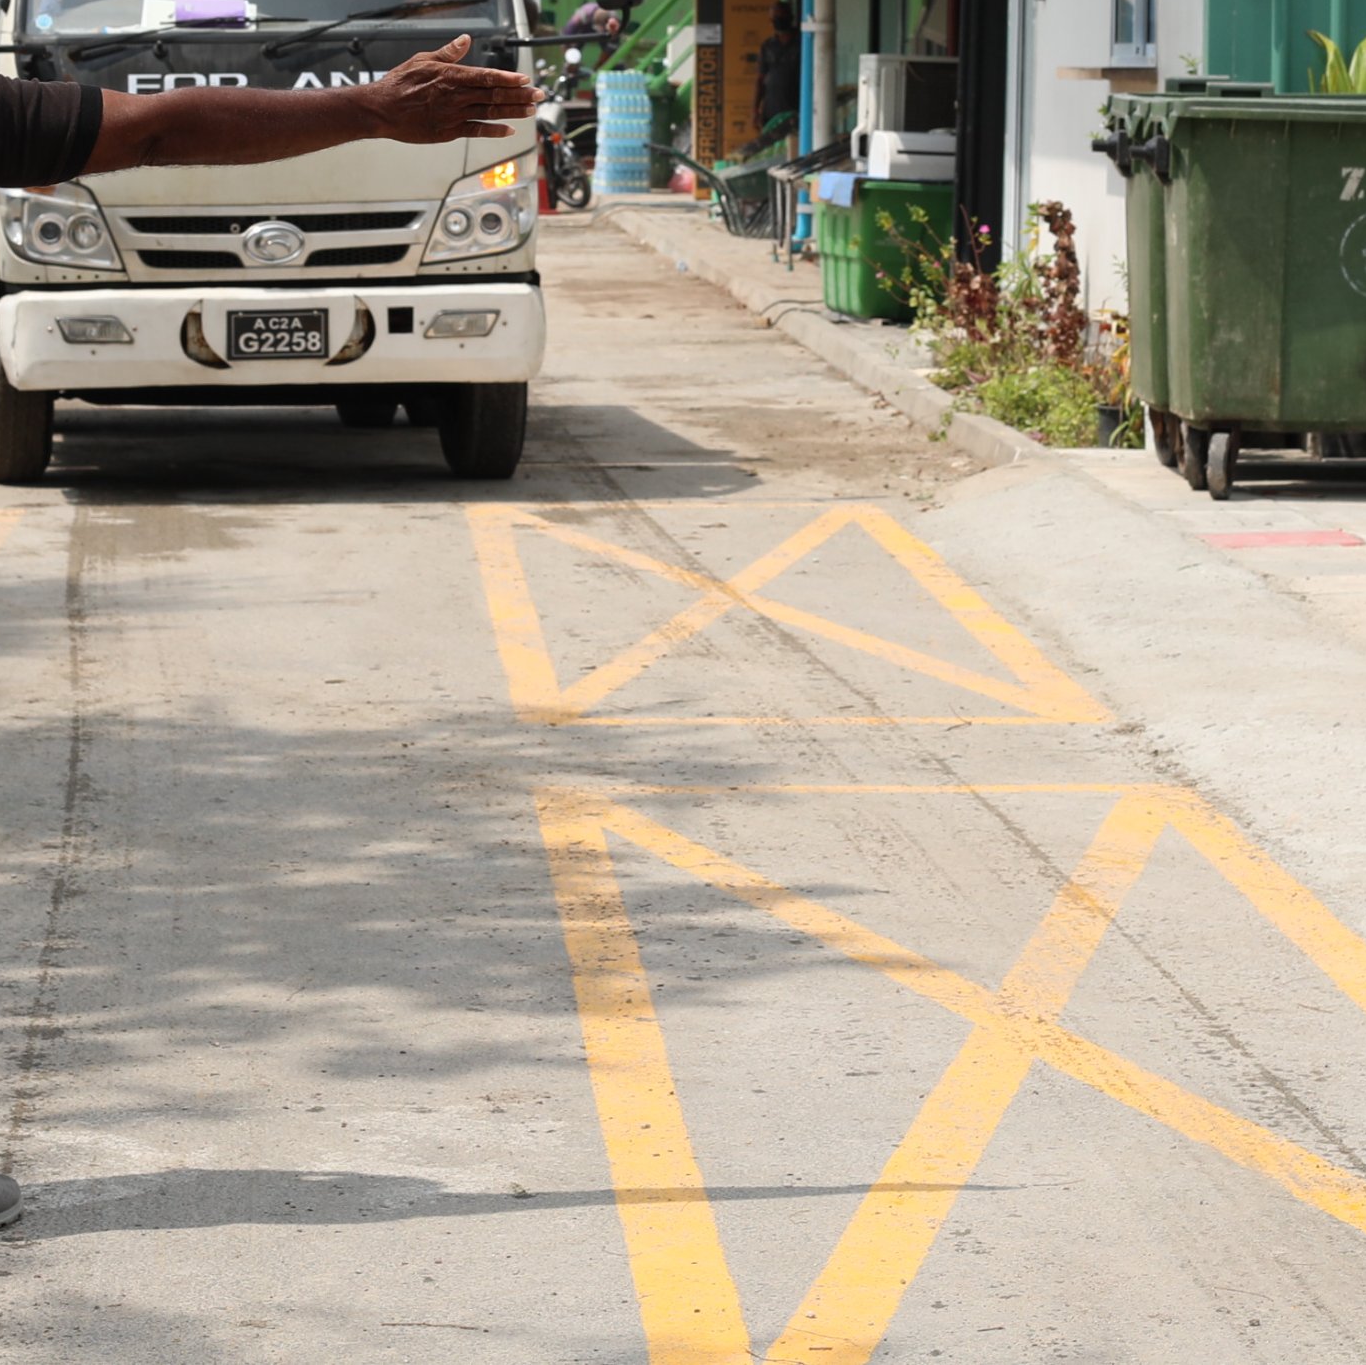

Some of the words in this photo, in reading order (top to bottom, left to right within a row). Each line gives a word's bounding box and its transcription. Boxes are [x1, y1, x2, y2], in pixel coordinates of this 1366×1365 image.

[699, 46, 716, 172] EFRIGERATOR
[1339, 166, 1366, 202] Z
[238, 331, 322, 353] G2258
